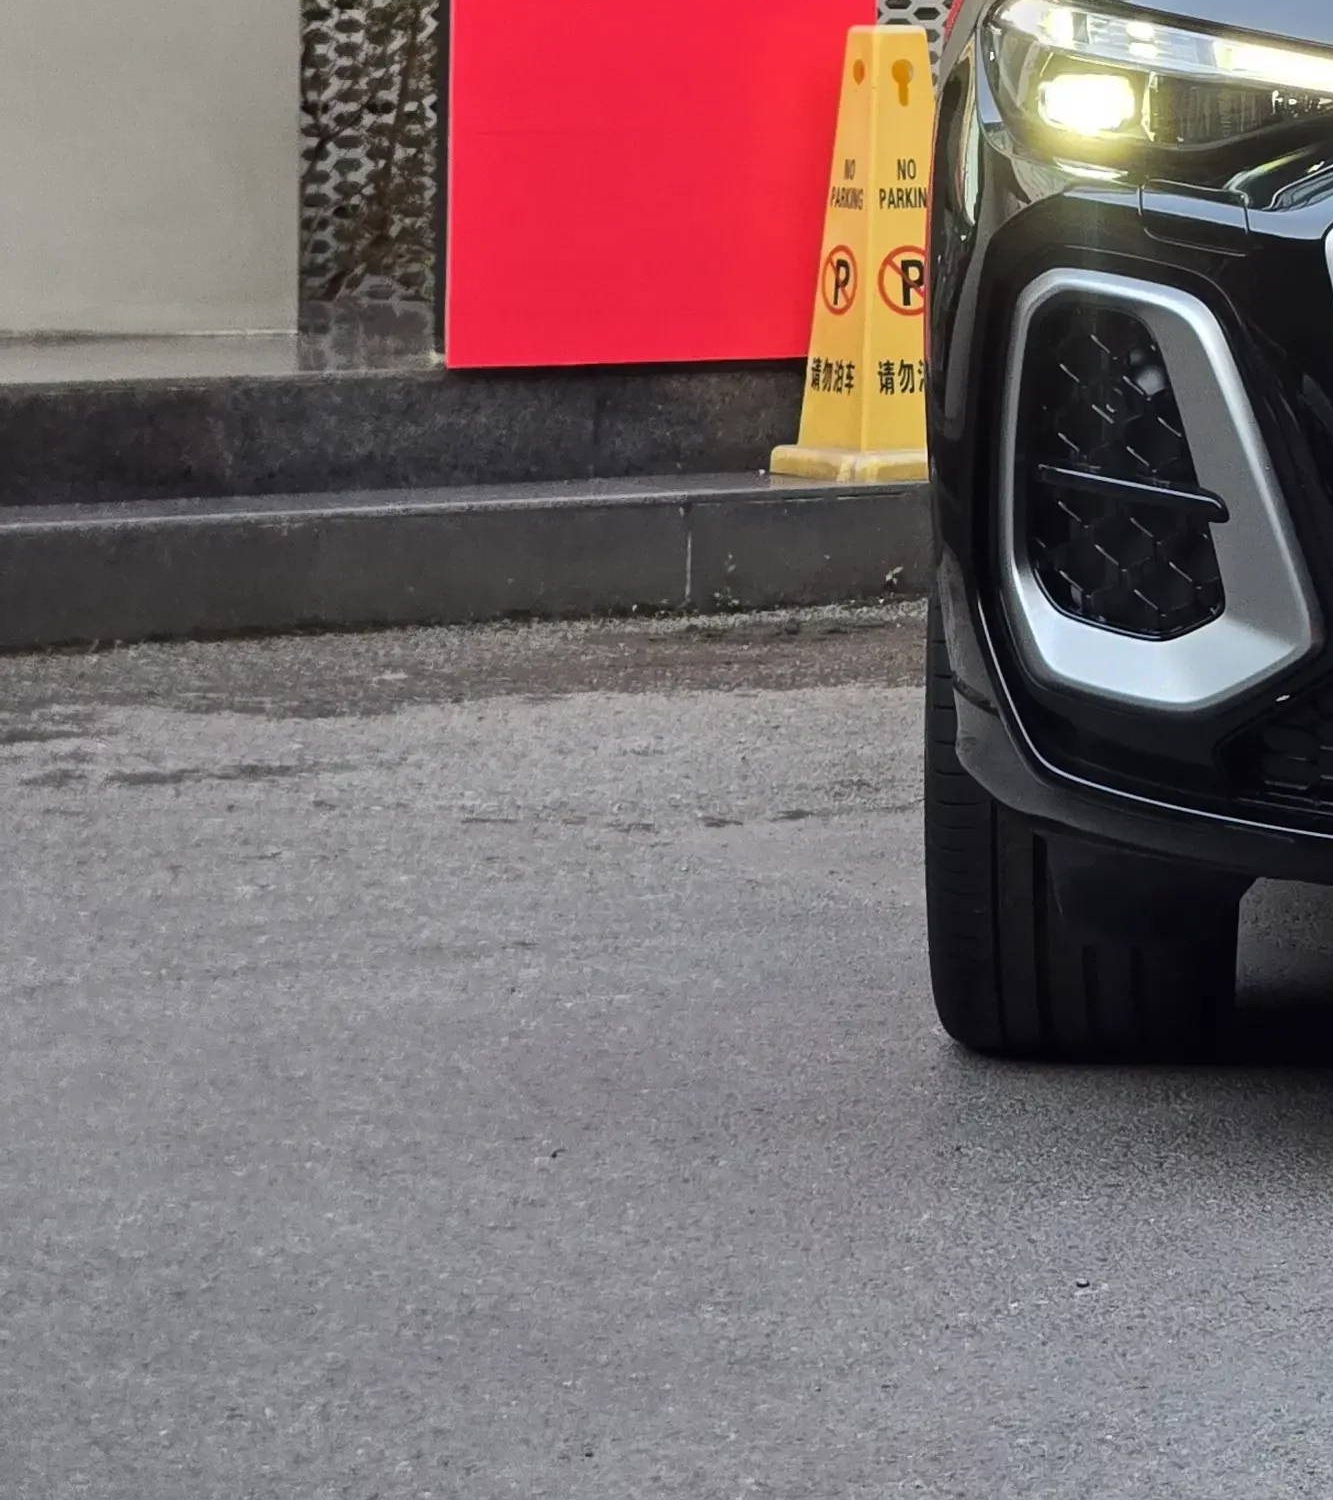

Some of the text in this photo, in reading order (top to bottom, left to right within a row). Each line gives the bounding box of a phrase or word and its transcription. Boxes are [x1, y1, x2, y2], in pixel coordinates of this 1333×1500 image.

[843, 158, 856, 181] NO
[896, 158, 917, 181] NO
[829, 186, 864, 211] PARKING
[878, 186, 928, 210] PARKIN
[810, 356, 856, 397] 请勿泊车
[877, 359, 925, 396] 请勿
